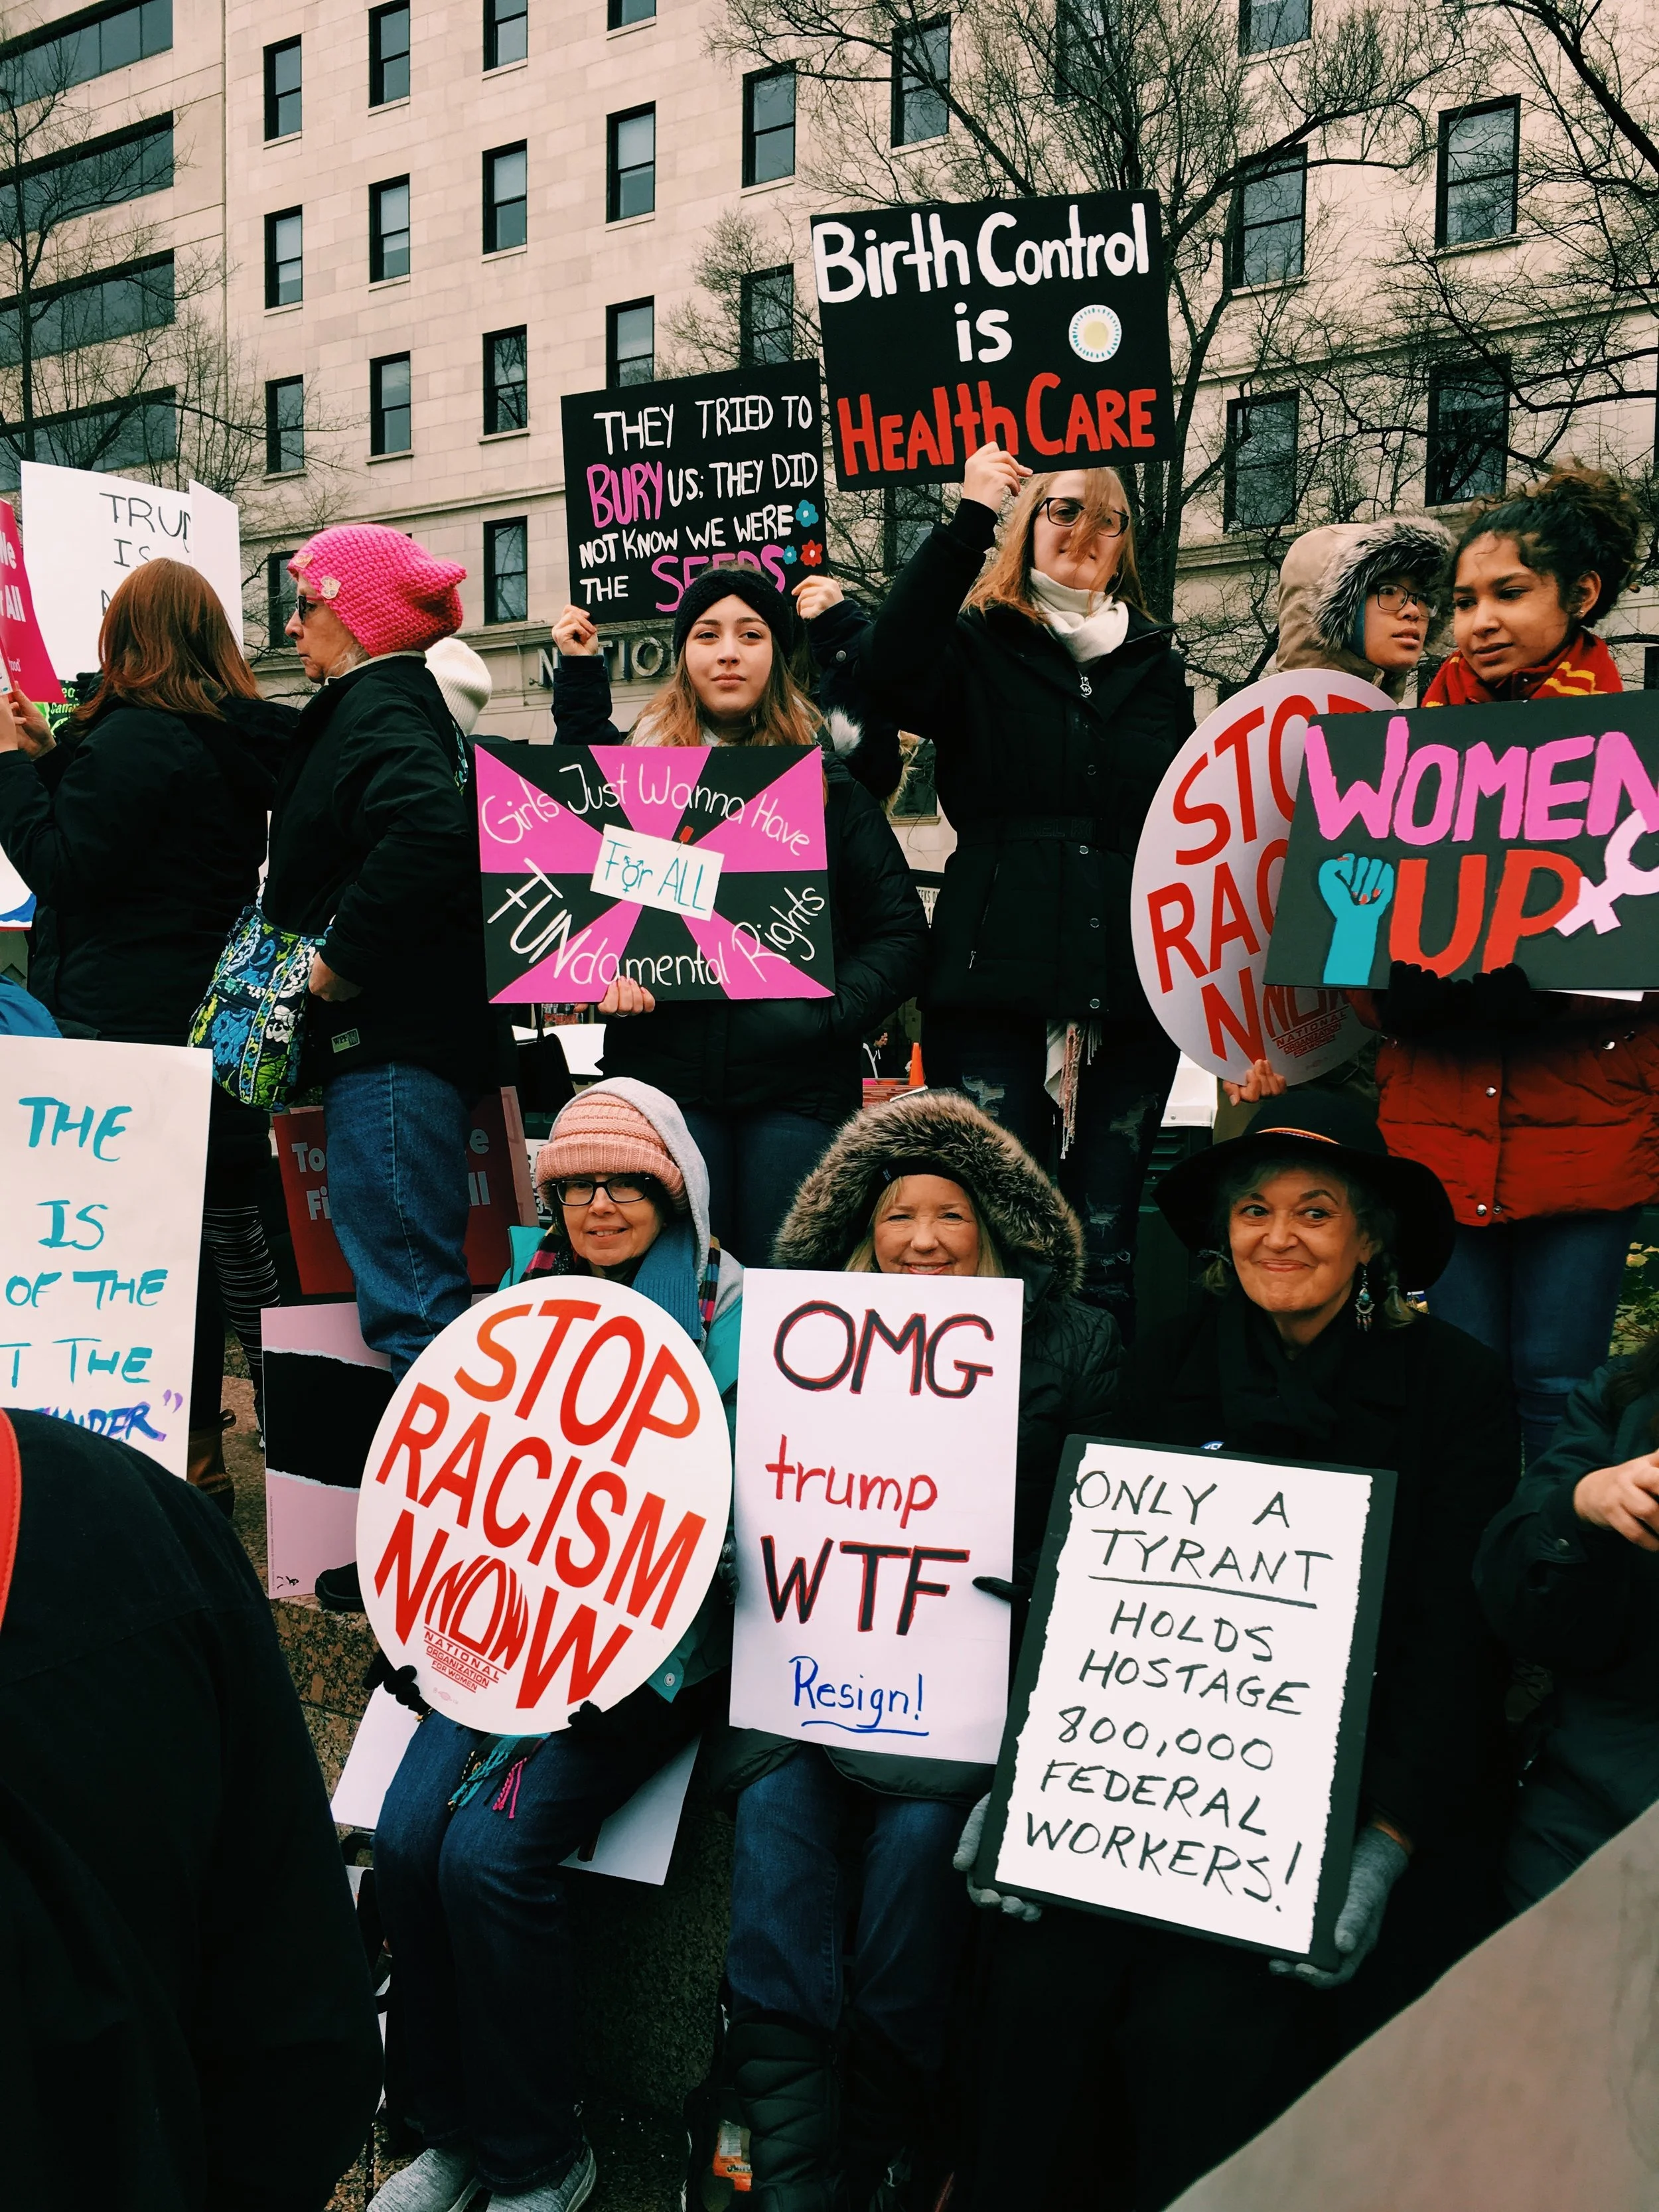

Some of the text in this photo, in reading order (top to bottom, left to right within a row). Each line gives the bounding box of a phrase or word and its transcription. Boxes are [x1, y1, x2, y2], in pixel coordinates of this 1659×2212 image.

[812, 202, 1149, 303] Birth Control
[954, 302, 1012, 362] is
[593, 396, 813, 455] THEY TRIED TO
[587, 461, 663, 528] BURY
[709, 459, 764, 498] THEY
[772, 453, 818, 488] DID
[580, 504, 794, 569] NOT KNOW WE WERE
[580, 575, 628, 605] THE
[482, 764, 810, 855] Girls Just Wanna Have
[1173, 694, 1374, 865] STO
[1305, 716, 1659, 846] WOMEN
[605, 840, 707, 911] For ALL
[732, 887, 825, 982] Rights
[1389, 849, 1584, 978] UP
[1277, 1009, 1346, 1047] NATIONAL
[1283, 1022, 1342, 1053] ORGANIZATION
[19, 1097, 132, 1162] THE
[36, 1199, 108, 1250] IS
[5, 1269, 168, 1309] OF THE
[52, 1338, 153, 1384] THE
[774, 1300, 993, 1398] OMG
[454, 1299, 700, 1467] STOP
[375, 1381, 706, 1631] RACISM
[764, 1434, 938, 1529] trump
[1076, 1469, 1291, 1528] ONLY A
[760, 1535, 970, 1637] WTF
[1090, 1529, 1334, 1591] TYRANT
[425, 1631, 499, 1680] NATIONAL
[1110, 1600, 1274, 1662] HOLDS
[426, 1645, 490, 1687] ORGANIZATION
[432, 1660, 478, 1690] FOR WOMEN
[788, 1655, 923, 1729] Resign!
[1078, 1649, 1311, 1716] HOSTAGE
[1058, 1705, 1273, 1771] 800,000
[1040, 1759, 1267, 1837] FEDERAL
[1026, 1811, 1302, 1913] WORKERS!
